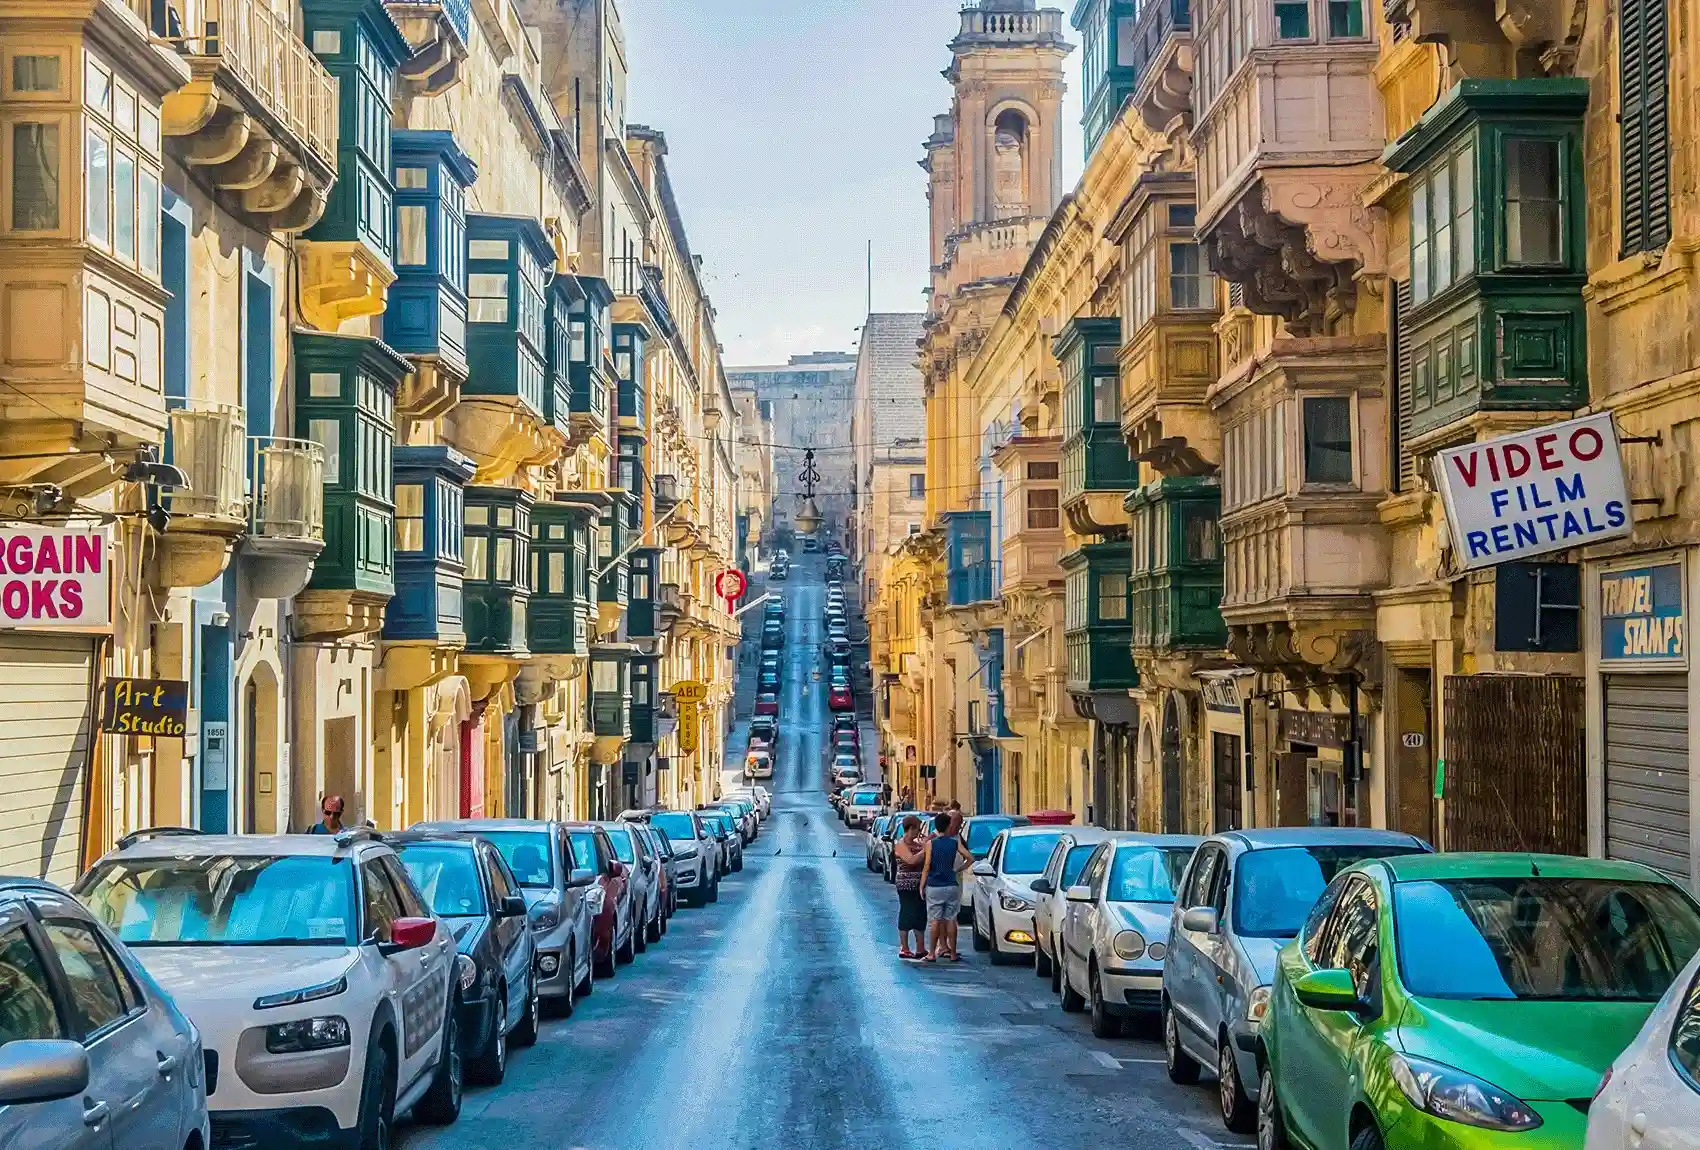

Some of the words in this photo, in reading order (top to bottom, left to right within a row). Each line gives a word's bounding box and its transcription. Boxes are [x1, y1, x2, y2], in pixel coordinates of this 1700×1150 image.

[1452, 427, 1604, 488] VIDEO
[1490, 472, 1586, 518] FILM
[1466, 500, 1626, 559] RENTALS
[0, 534, 102, 575] GAIN
[0, 579, 83, 619] OKS
[1602, 575, 1653, 616] TRAVEL
[1623, 615, 1683, 655] STAMPS
[677, 686, 700, 698] ABC
[118, 712, 184, 735] Studio
[1404, 733, 1421, 746] 40
